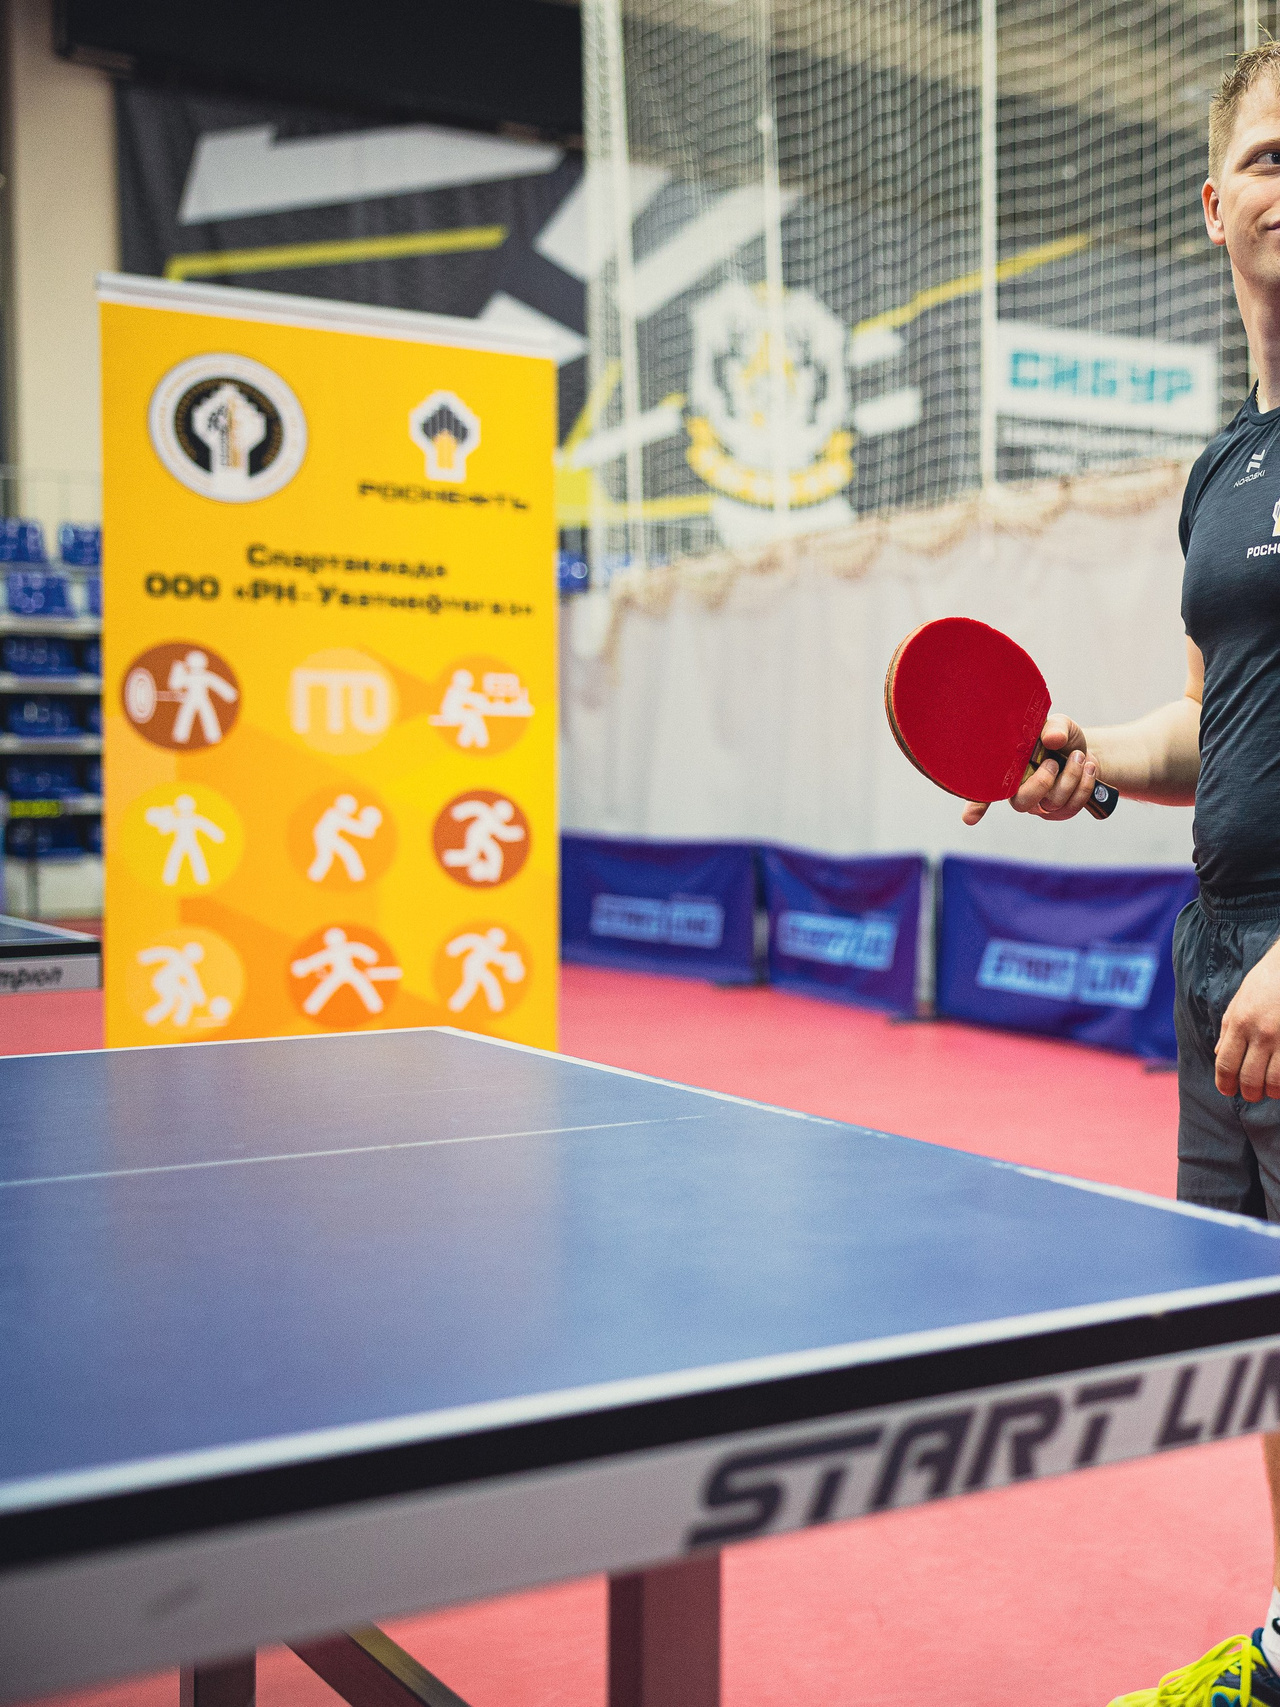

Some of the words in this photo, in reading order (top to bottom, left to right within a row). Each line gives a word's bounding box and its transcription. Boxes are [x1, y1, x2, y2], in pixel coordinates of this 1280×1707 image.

[1011, 352, 1193, 404] СИБУР
[145, 574, 220, 600] ООО
[292, 668, 388, 734] ГТО
[688, 1373, 1143, 1548] START
